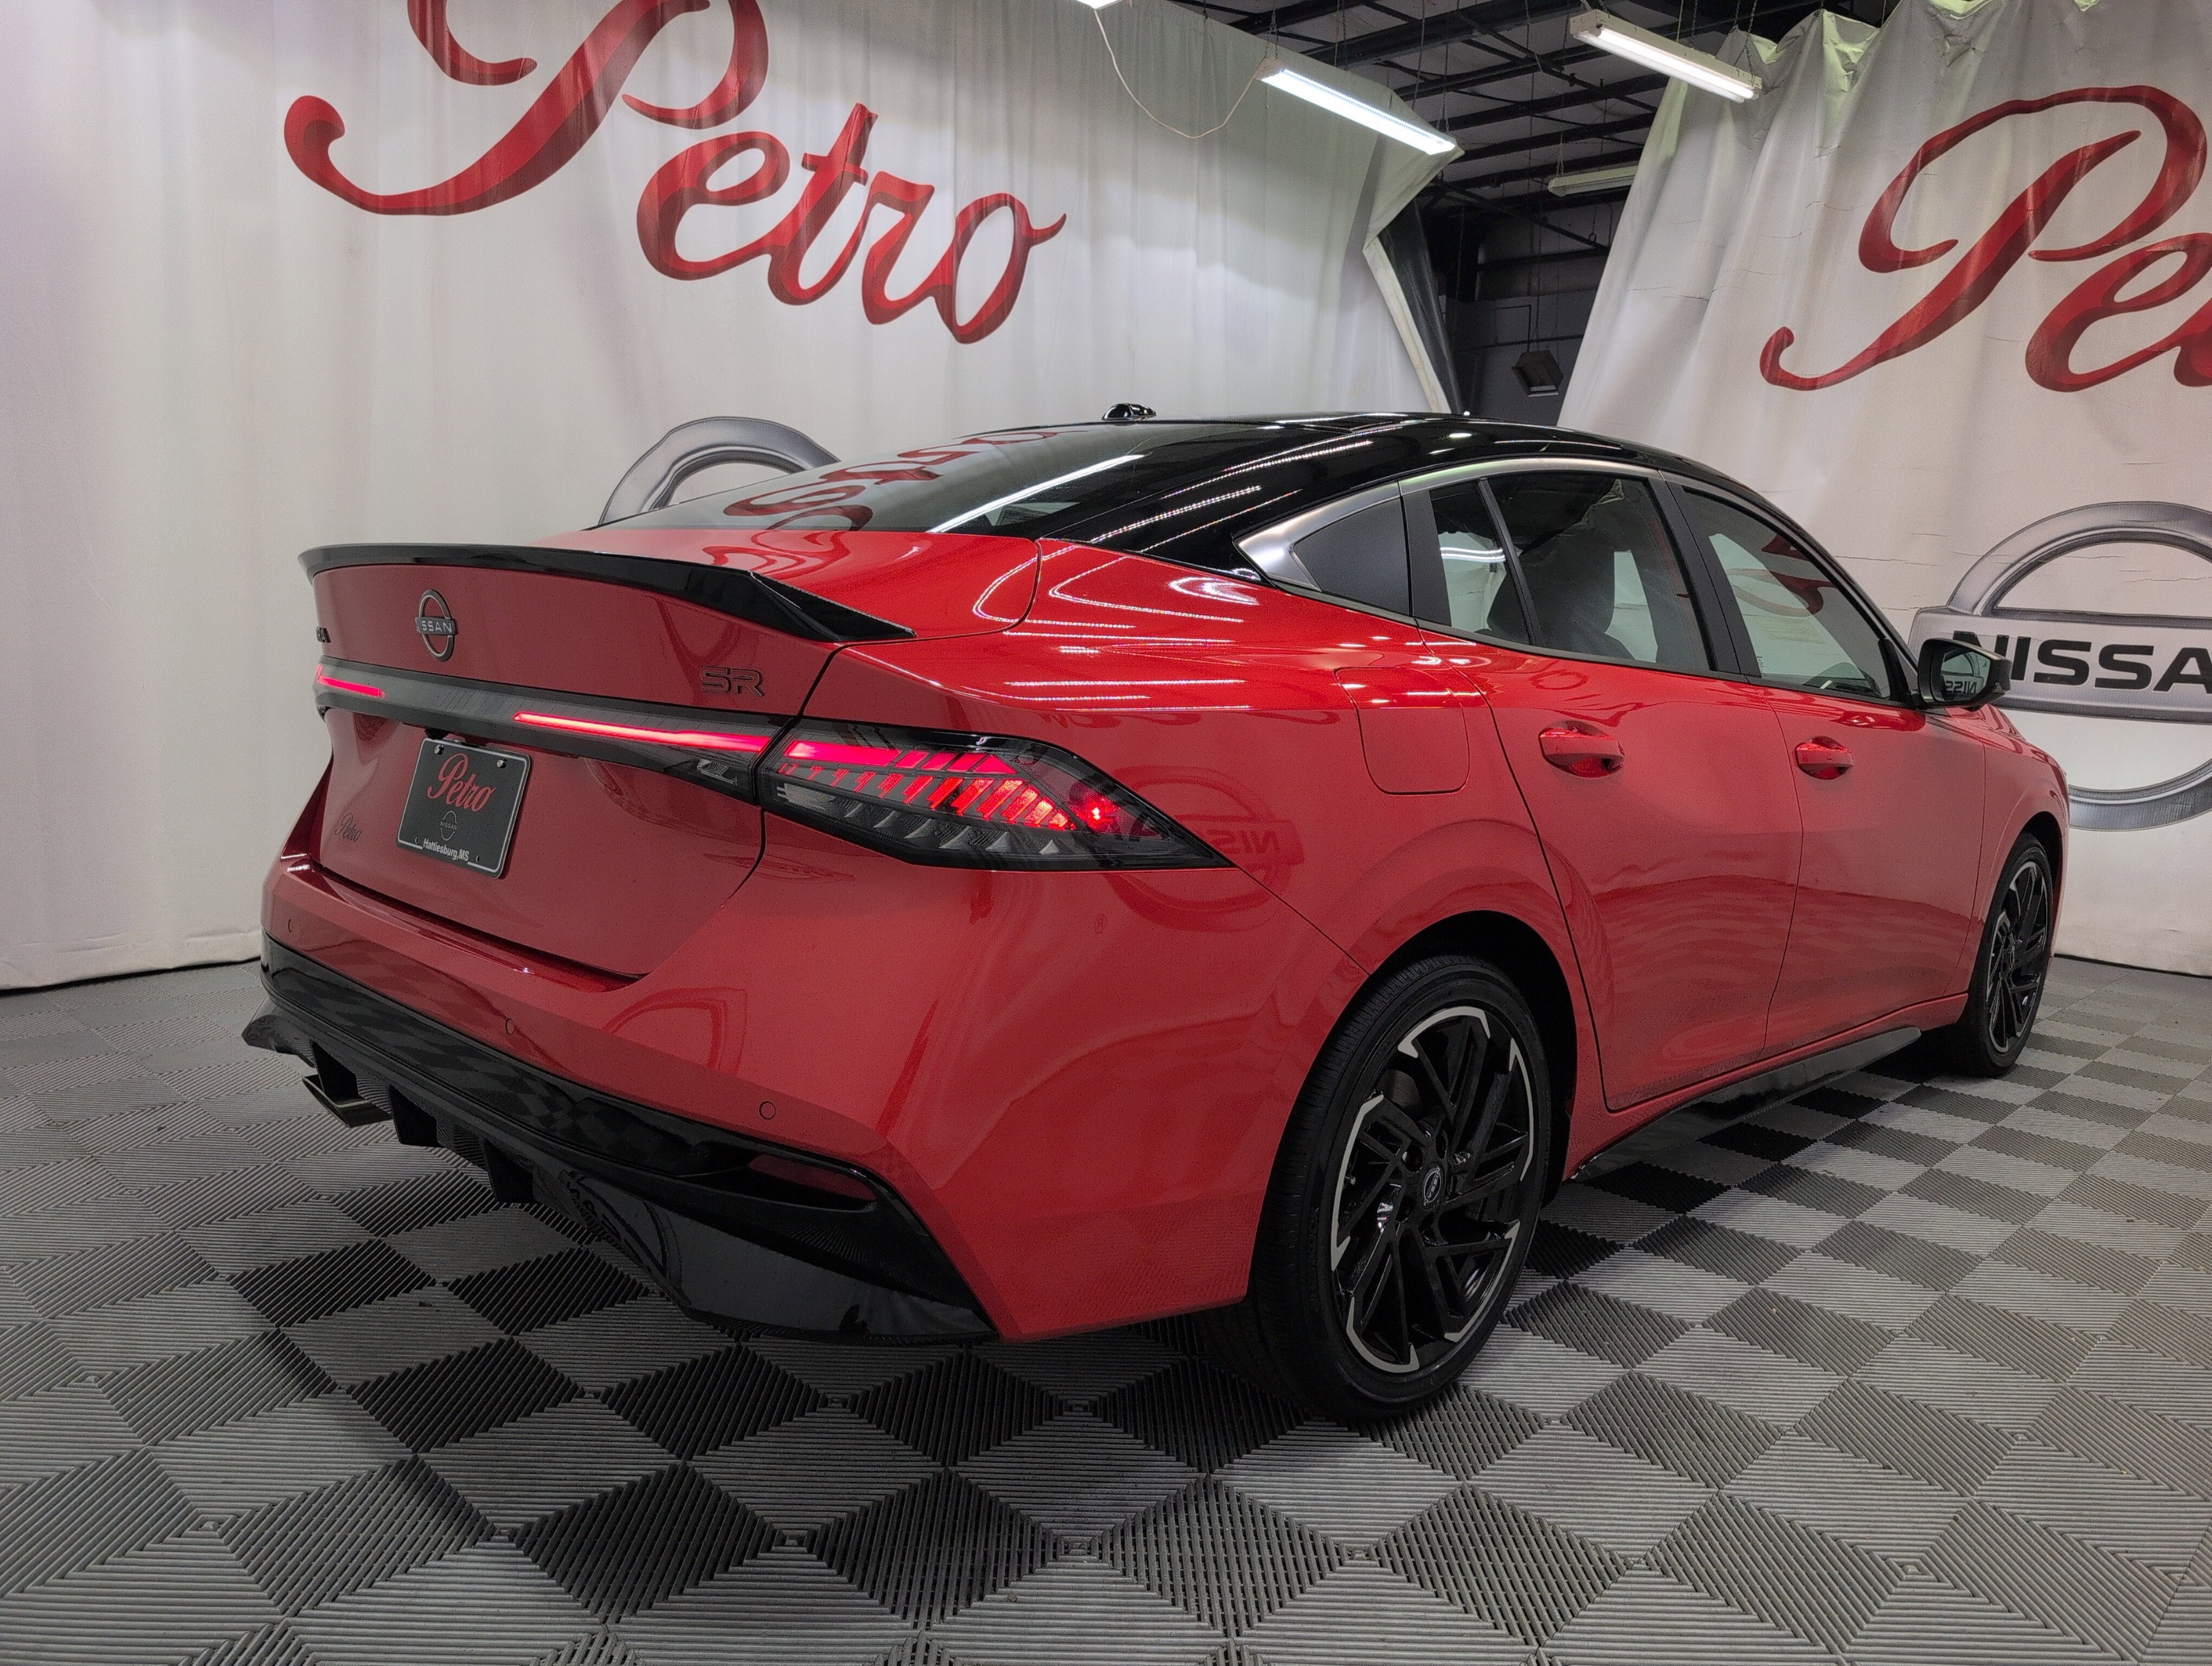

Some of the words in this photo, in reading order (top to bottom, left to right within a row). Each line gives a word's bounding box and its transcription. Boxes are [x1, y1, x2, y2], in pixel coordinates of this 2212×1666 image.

[284, 0, 1066, 344] Petro
[417, 620, 452, 633] SSAN
[700, 665, 764, 696] SR
[427, 753, 496, 812] Petro
[440, 821, 458, 830] NISSAN
